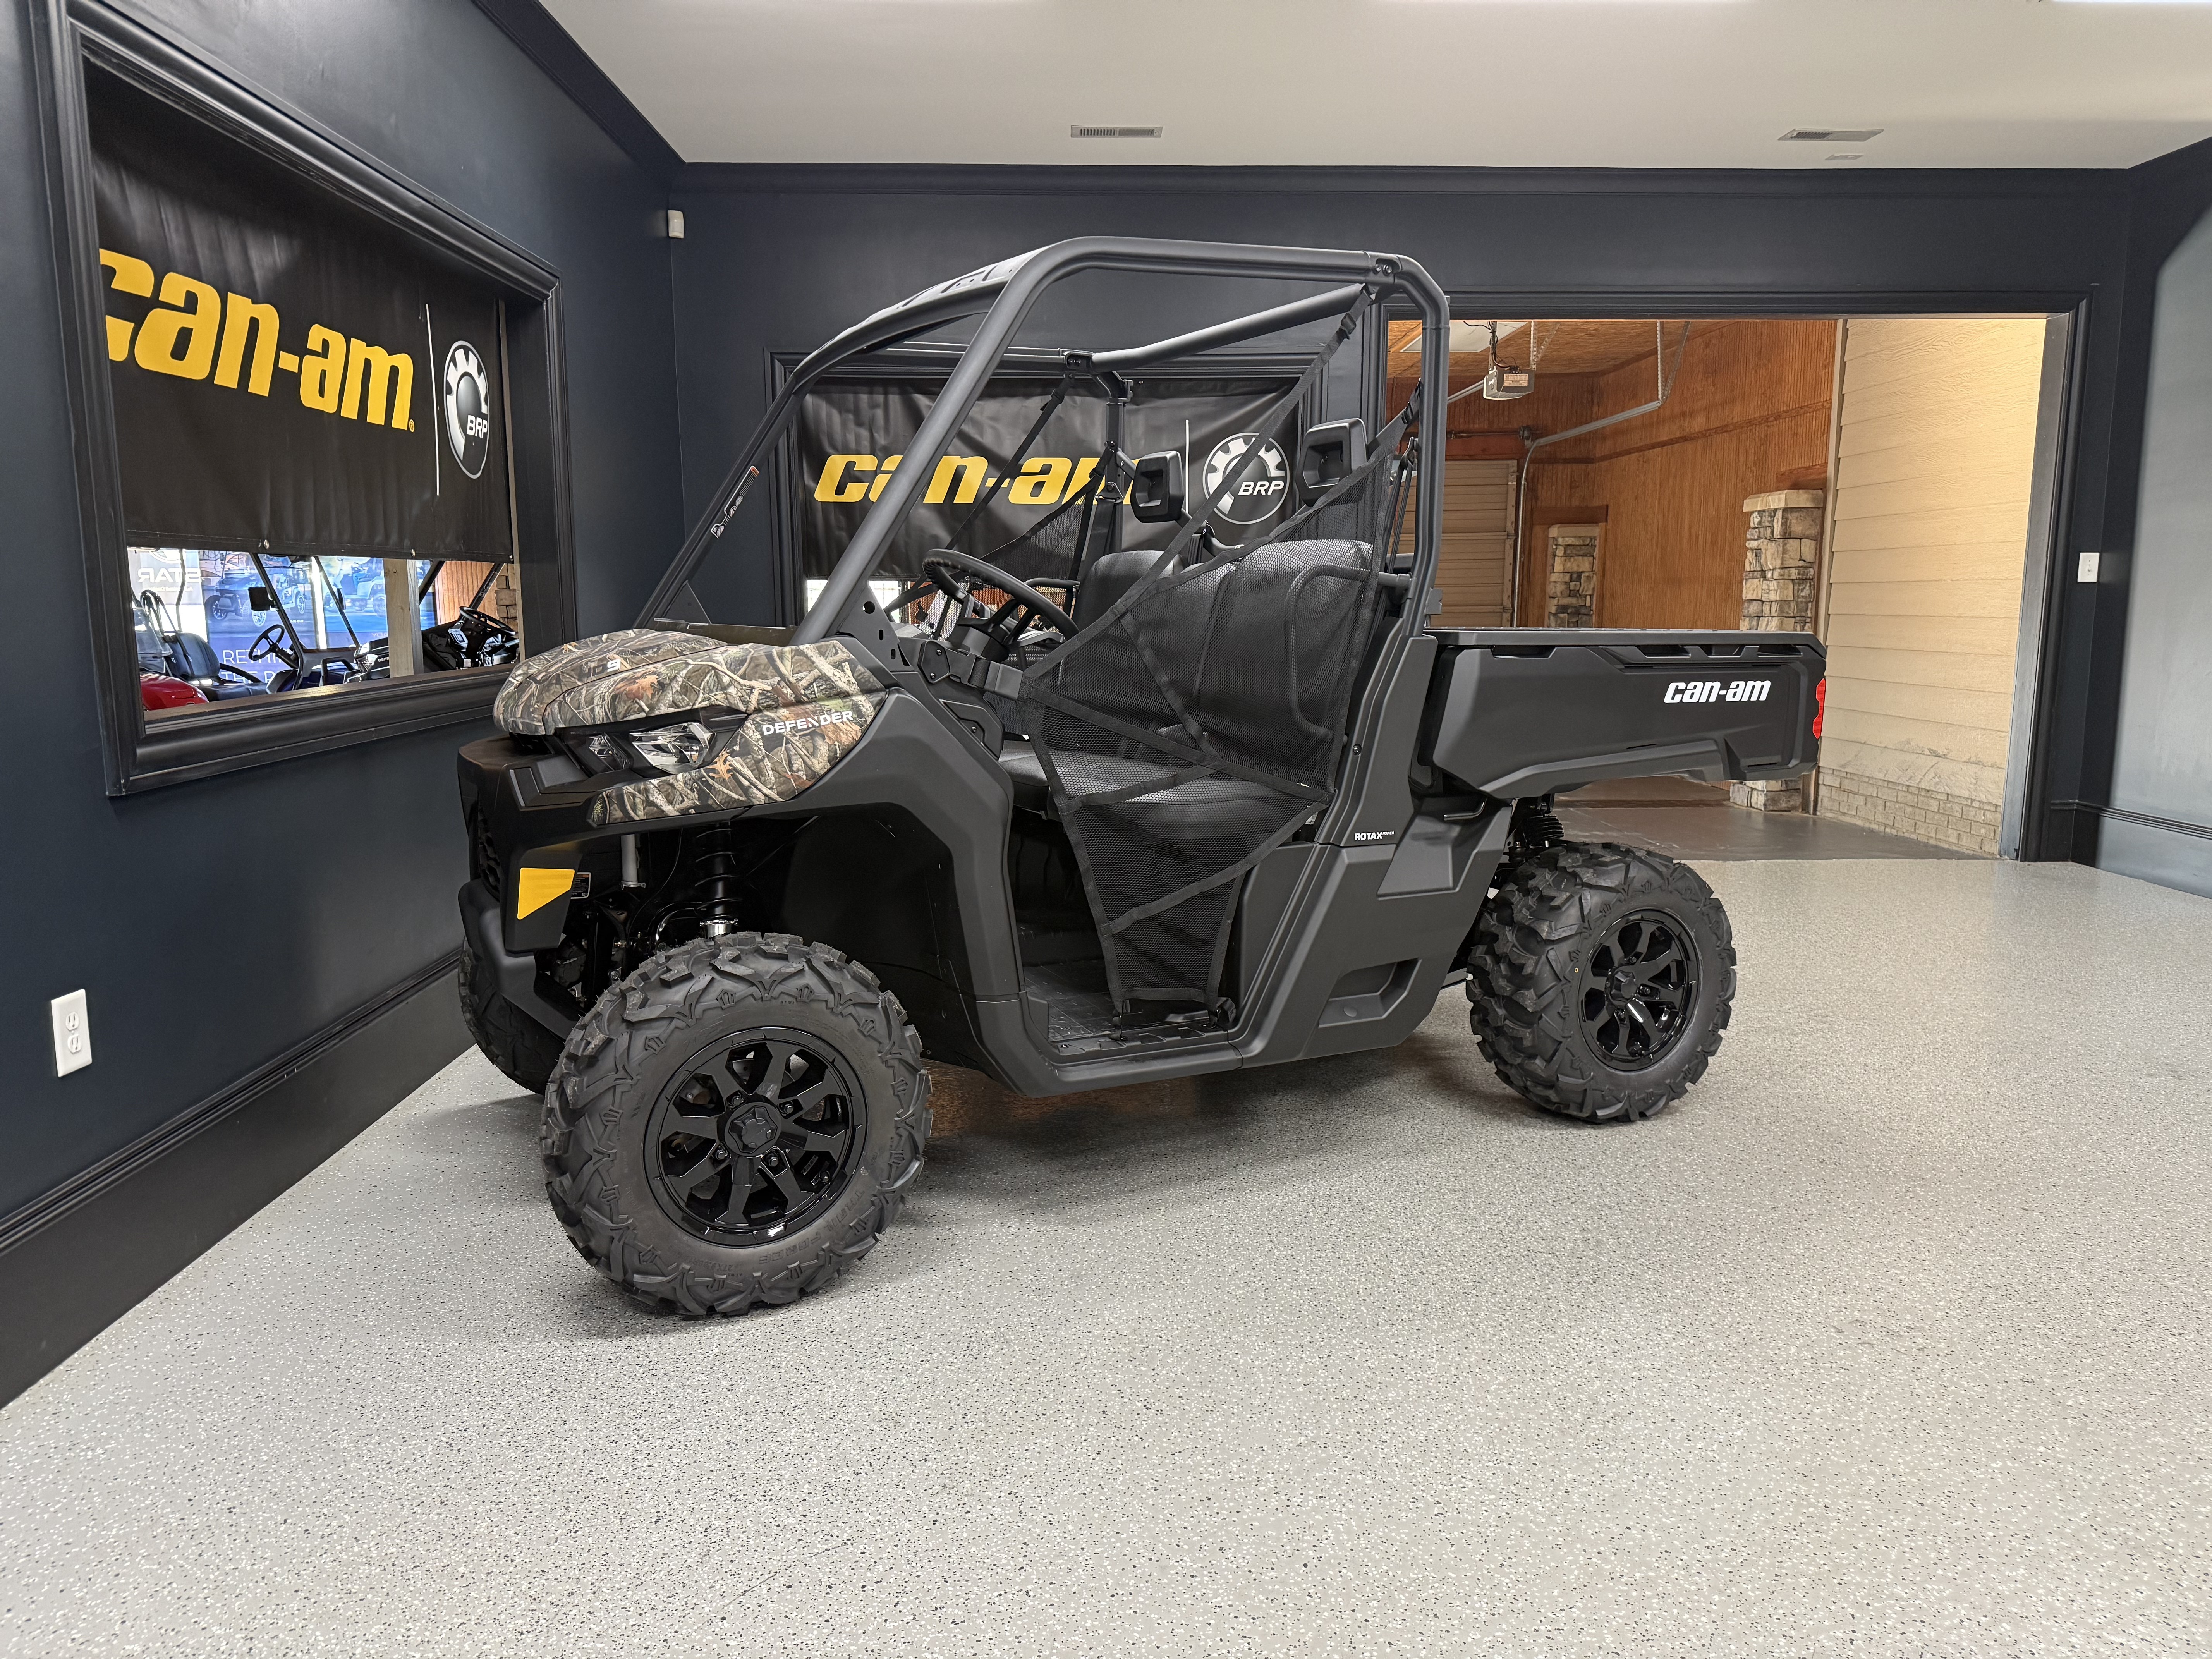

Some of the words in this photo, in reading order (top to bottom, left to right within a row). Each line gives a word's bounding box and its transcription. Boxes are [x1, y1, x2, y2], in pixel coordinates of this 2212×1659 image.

[467, 415, 488, 438] BRP
[1238, 481, 1284, 495] BRP
[1664, 680, 1771, 703] can-am
[763, 711, 854, 735] DEFENDER
[1355, 832, 1382, 840] ROTAX
[759, 1231, 822, 1265] FORCE
